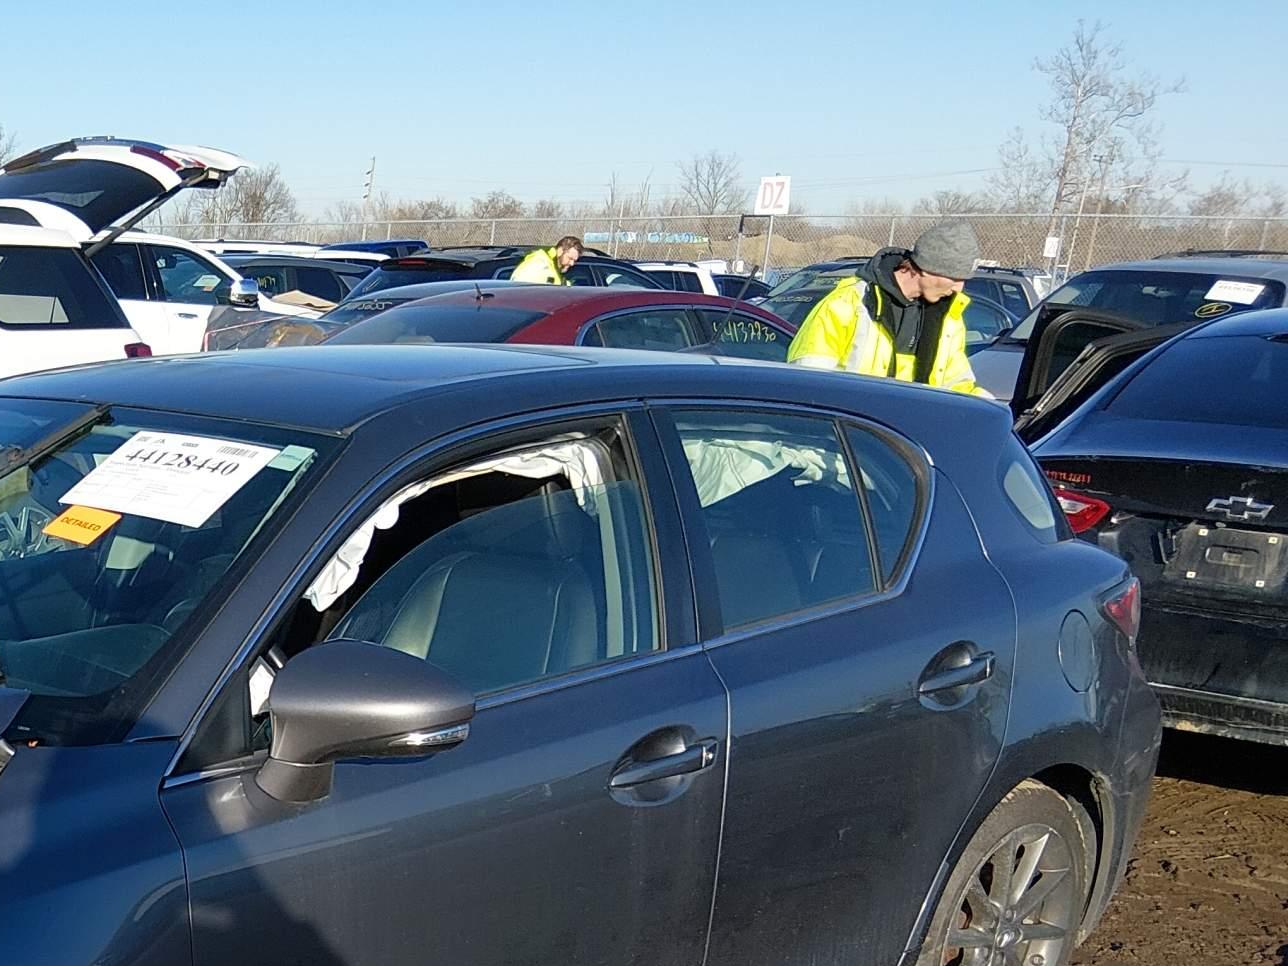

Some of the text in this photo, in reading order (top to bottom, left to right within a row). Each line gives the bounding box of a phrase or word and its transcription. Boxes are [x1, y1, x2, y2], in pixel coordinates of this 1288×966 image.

[760, 181, 786, 209] DZ
[124, 449, 239, 476] 44128440
[60, 516, 101, 531] DETAILED
